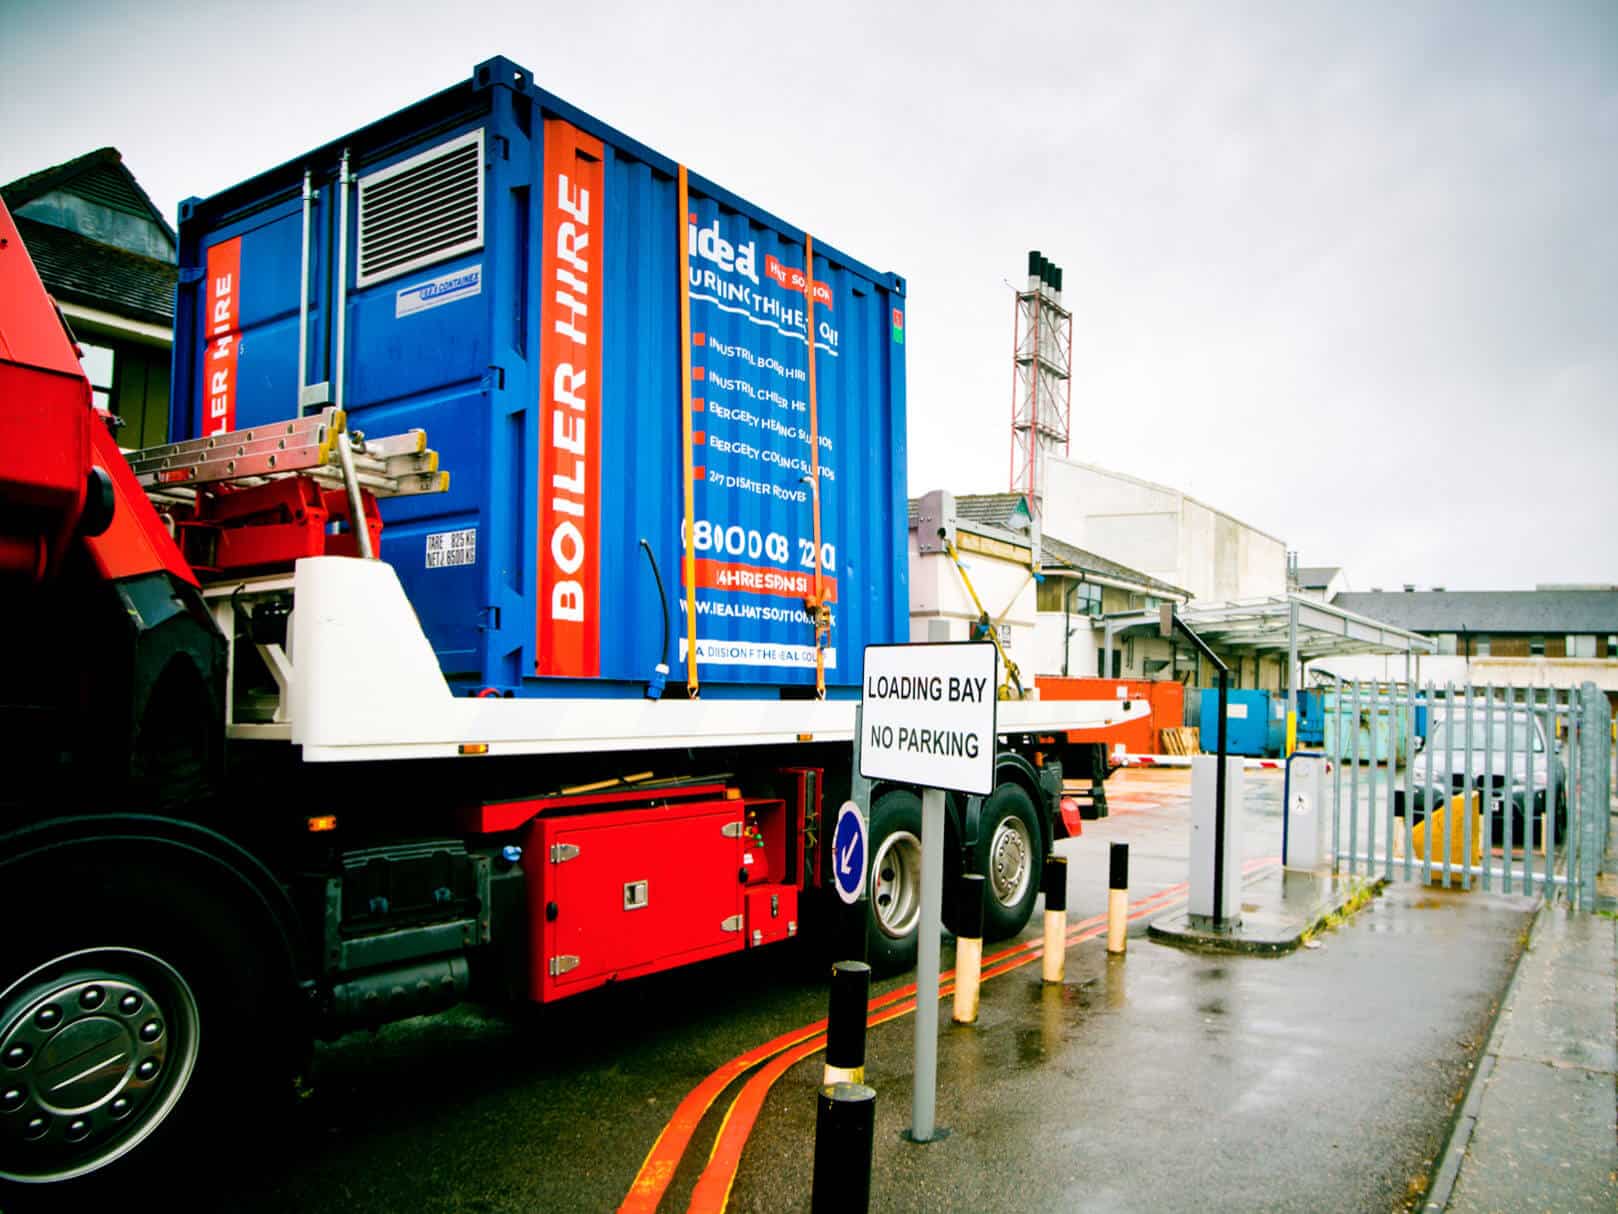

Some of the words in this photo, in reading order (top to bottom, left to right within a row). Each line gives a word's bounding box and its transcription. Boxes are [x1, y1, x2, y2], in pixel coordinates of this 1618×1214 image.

[554, 172, 590, 346] HIRE
[214, 272, 234, 360] HIRE
[551, 361, 587, 624] BOILER
[868, 675, 942, 702] LOADING
[948, 677, 988, 704] BAY
[870, 724, 894, 749] NO
[898, 727, 980, 759] PARKING
